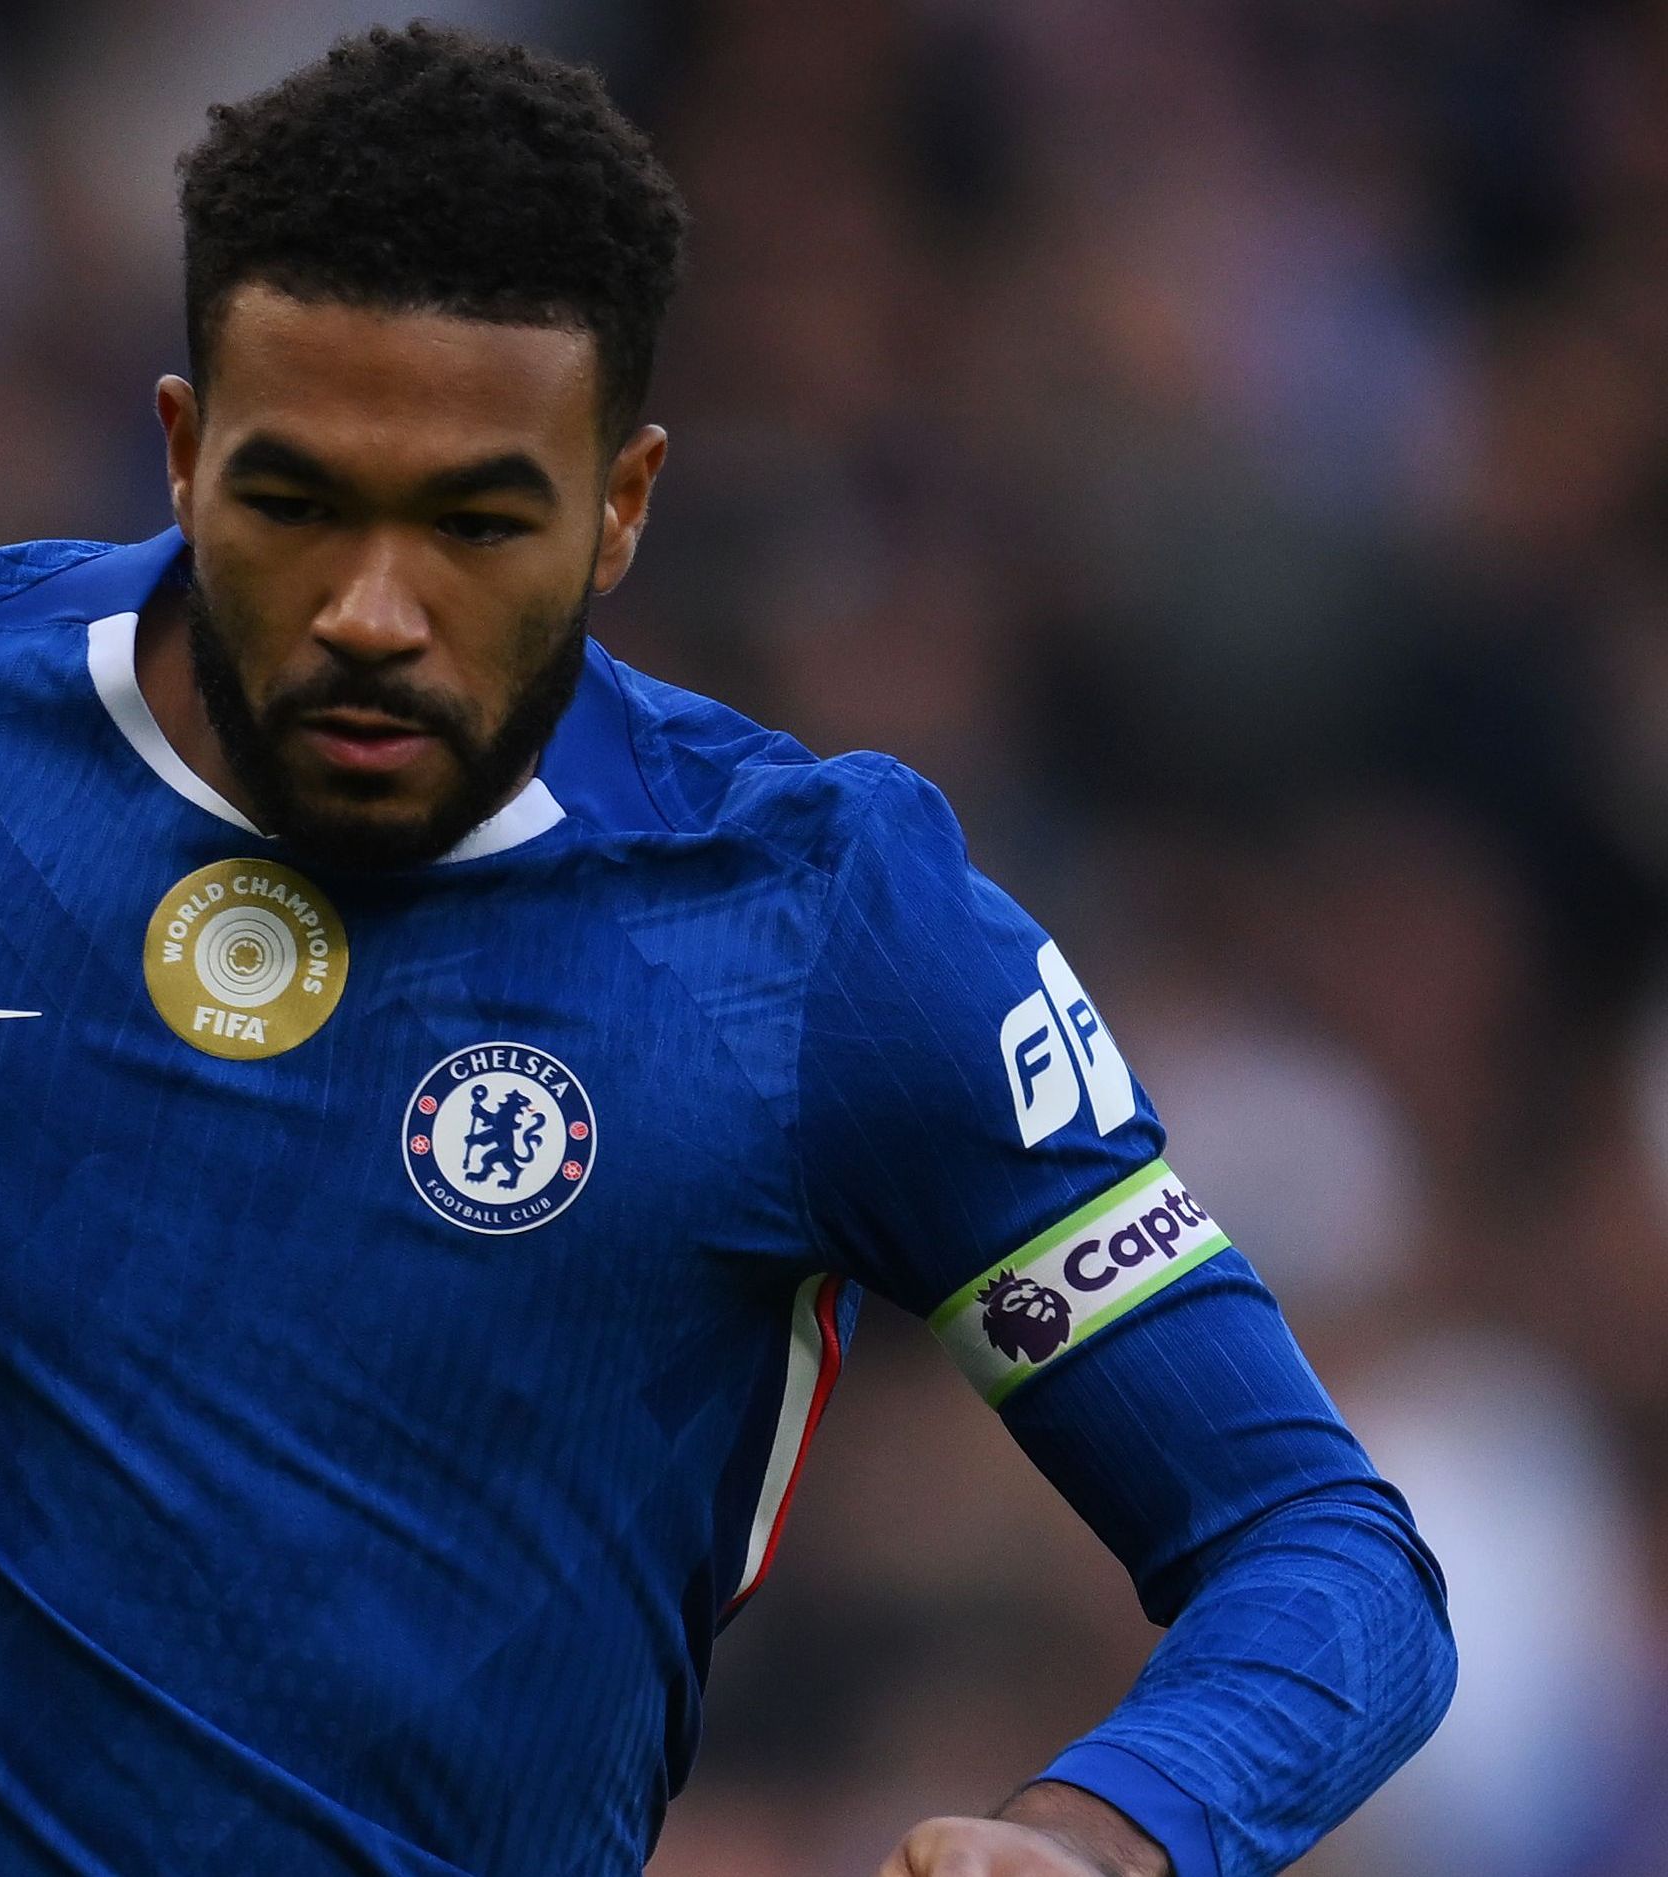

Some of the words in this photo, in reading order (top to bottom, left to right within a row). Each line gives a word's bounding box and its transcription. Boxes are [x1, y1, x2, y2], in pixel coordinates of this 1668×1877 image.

[163, 883, 224, 963] WORLD
[233, 876, 329, 994] CHAMPIONS
[193, 1006, 265, 1043] FIFA
[449, 1050, 570, 1098] CHELSEA
[426, 1179, 501, 1223] FOOTBALL
[510, 1197, 551, 1222] CLUB
